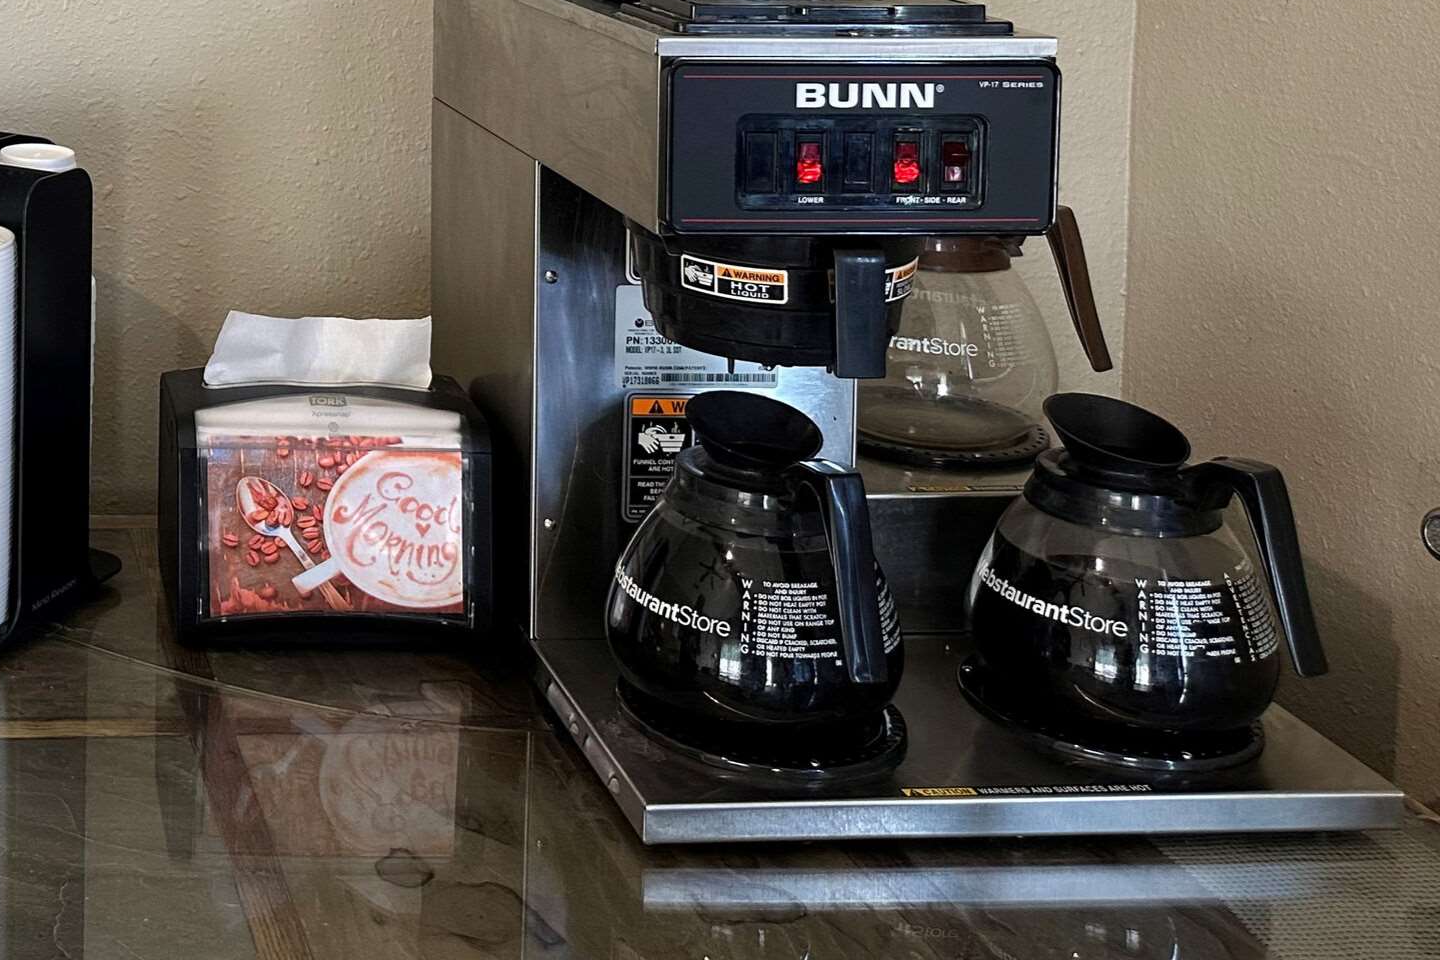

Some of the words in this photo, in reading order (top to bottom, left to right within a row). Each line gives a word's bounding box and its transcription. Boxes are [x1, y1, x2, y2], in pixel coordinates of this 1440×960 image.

[733, 272, 780, 282] WARNING
[730, 281, 770, 293] HOT
[731, 289, 769, 299] LIQUID
[889, 335, 978, 357] rantStore
[311, 396, 345, 405] TORK
[377, 471, 461, 533] Good
[616, 567, 731, 637] ebstaurantStore
